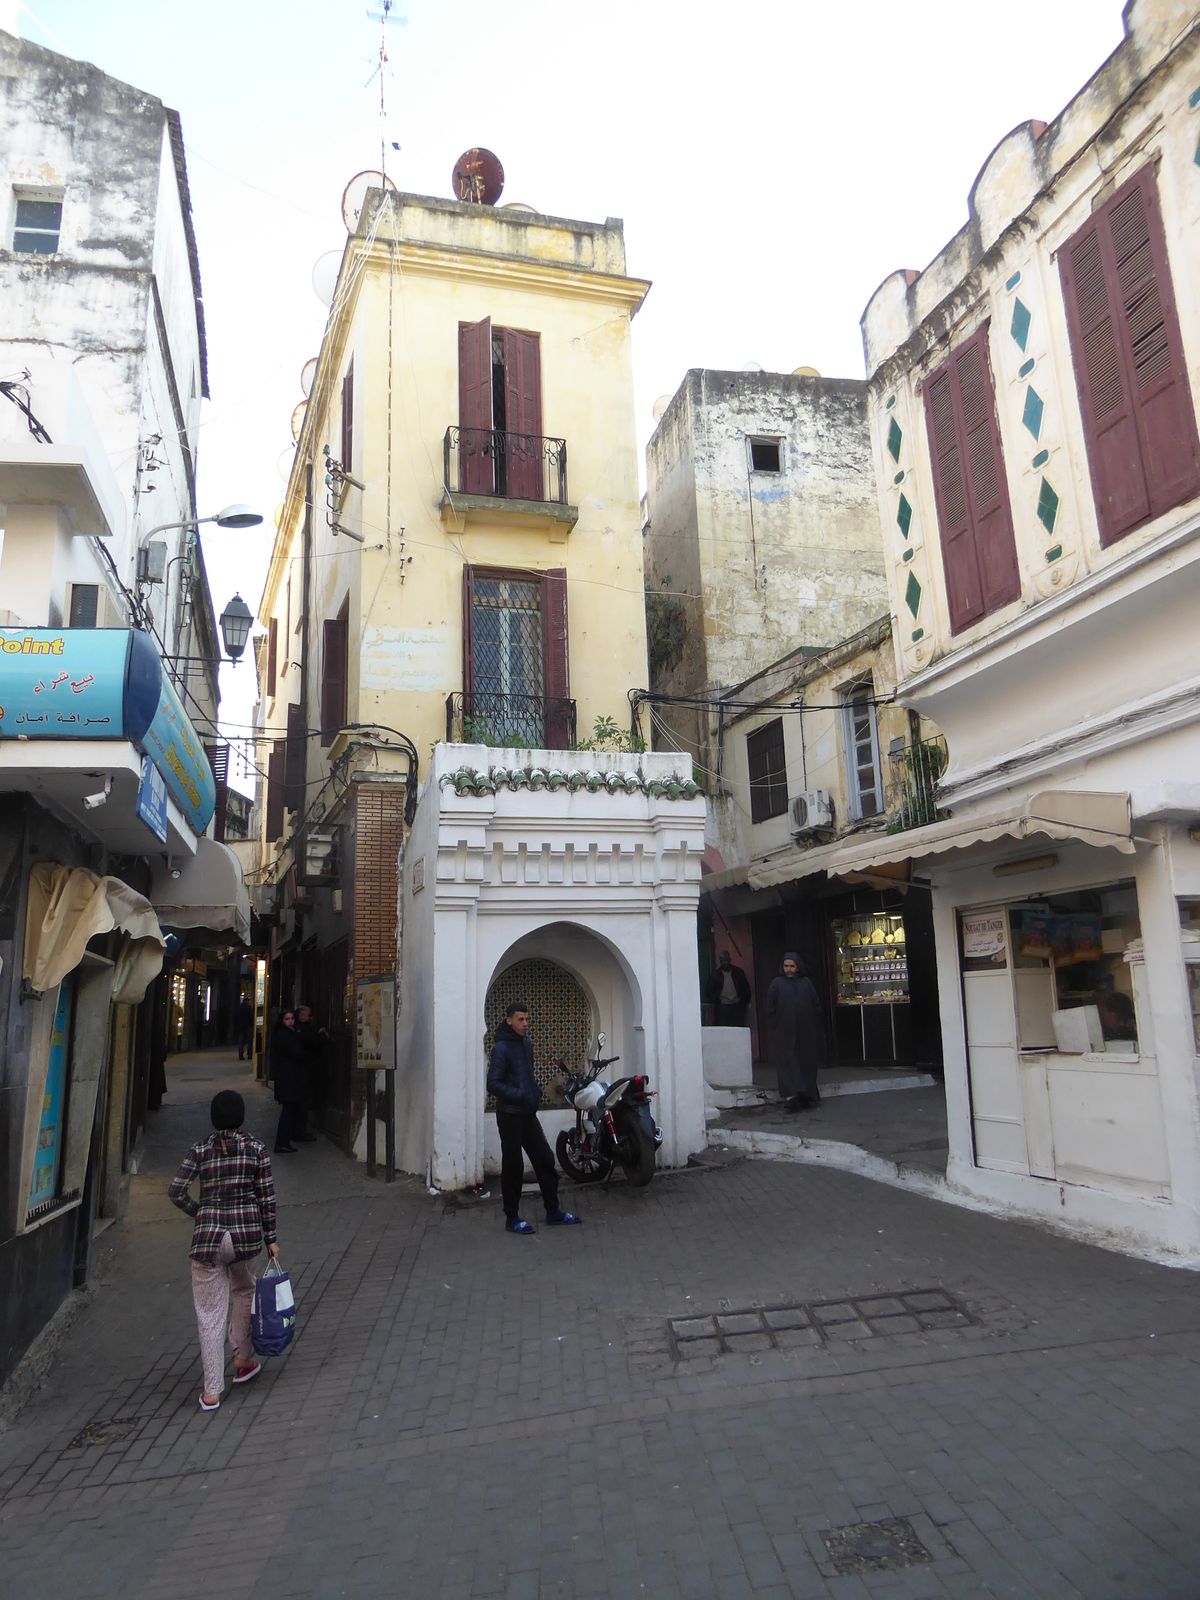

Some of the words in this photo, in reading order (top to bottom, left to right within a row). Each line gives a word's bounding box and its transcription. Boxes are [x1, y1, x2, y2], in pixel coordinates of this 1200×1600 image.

[0, 637, 64, 655] oint
[70, 674, 95, 694] بيع
[56, 712, 111, 726] صرافة
